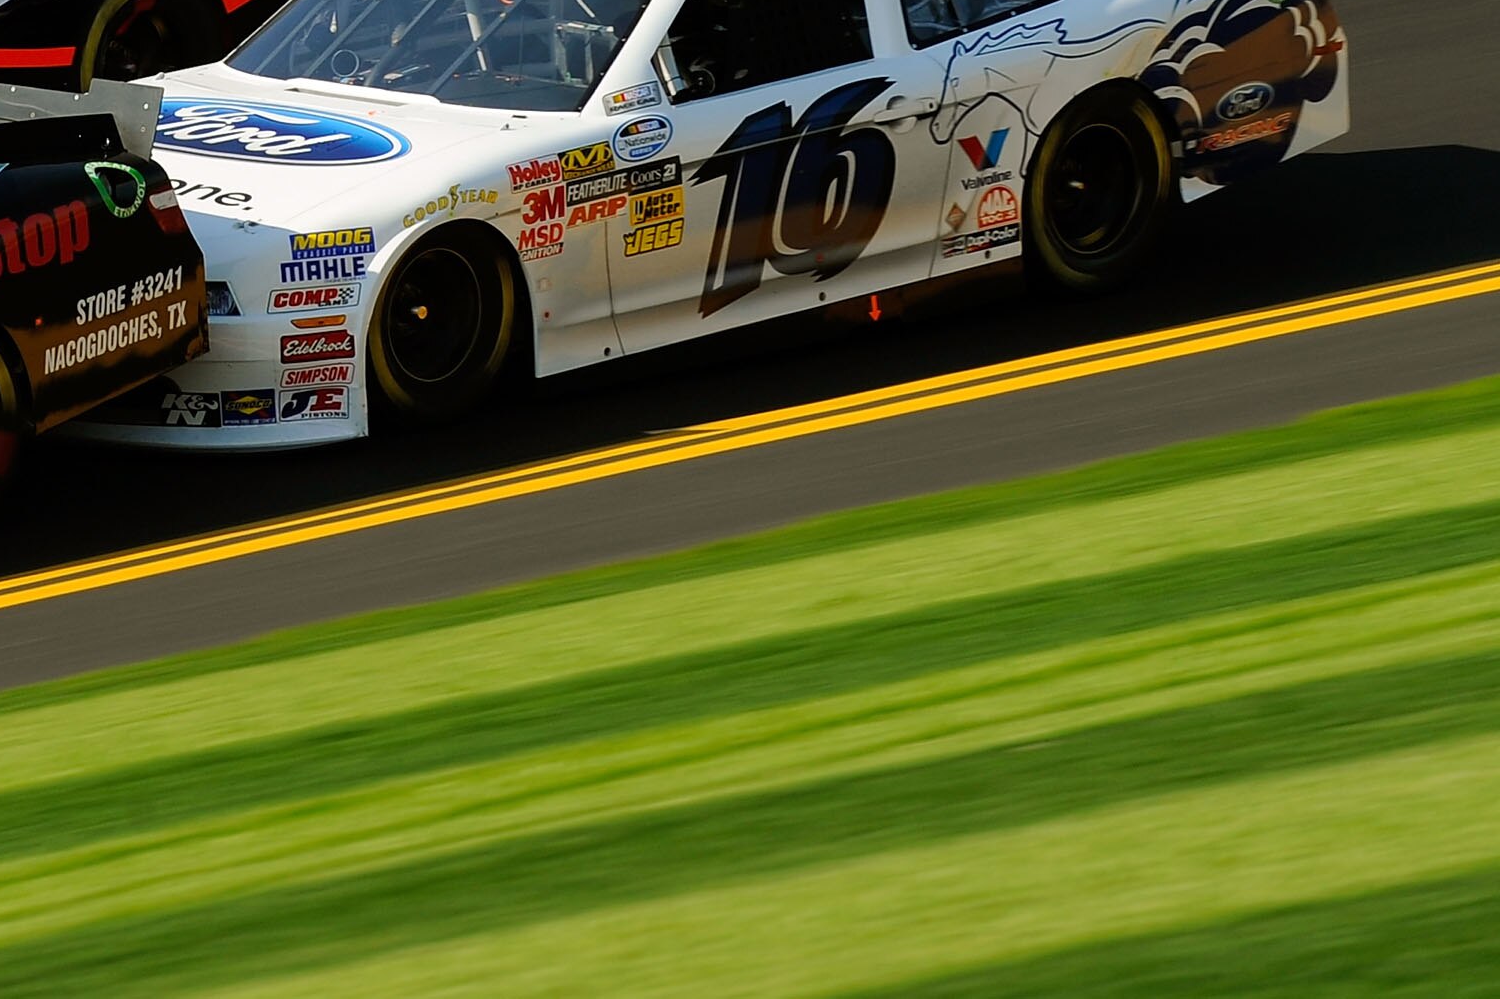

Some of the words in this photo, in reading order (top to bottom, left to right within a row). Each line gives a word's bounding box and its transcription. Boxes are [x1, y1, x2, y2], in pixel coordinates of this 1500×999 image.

[1224, 88, 1265, 118] Ford
[156, 104, 352, 156] Ford
[624, 133, 667, 149] Nationwide
[1197, 112, 1292, 154] RACING
[509, 160, 561, 186] Holley
[630, 169, 662, 185] Coors
[663, 163, 677, 177] 21
[961, 171, 1013, 190] Valvoline
[114, 181, 146, 218] ETHANOL
[169, 178, 254, 211] one.
[567, 172, 627, 202] FEATHERLITE
[646, 192, 674, 207] Auto
[687, 76, 897, 319] 16
[403, 191, 498, 228] GOODYEAR
[522, 185, 565, 225] 3M
[567, 196, 627, 226] ARP
[644, 202, 680, 219] Meter
[293, 228, 373, 250] MOOG
[518, 224, 564, 251] MSD
[625, 220, 684, 256] JEGS
[296, 248, 338, 260] CHASSIS
[342, 243, 372, 254] PARTS
[281, 256, 366, 283] MAHLE
[75, 284, 126, 325] STORE
[131, 265, 184, 305] #3241
[273, 288, 339, 308] COMP
[317, 299, 348, 308] CAMS
[44, 313, 163, 375] NACOGDOCHES,
[168, 300, 188, 328] TX
[283, 338, 353, 357] Edelbrock
[285, 366, 350, 385] SIMPSON
[225, 399, 272, 410] SUNOCO
[281, 388, 344, 418] JE
